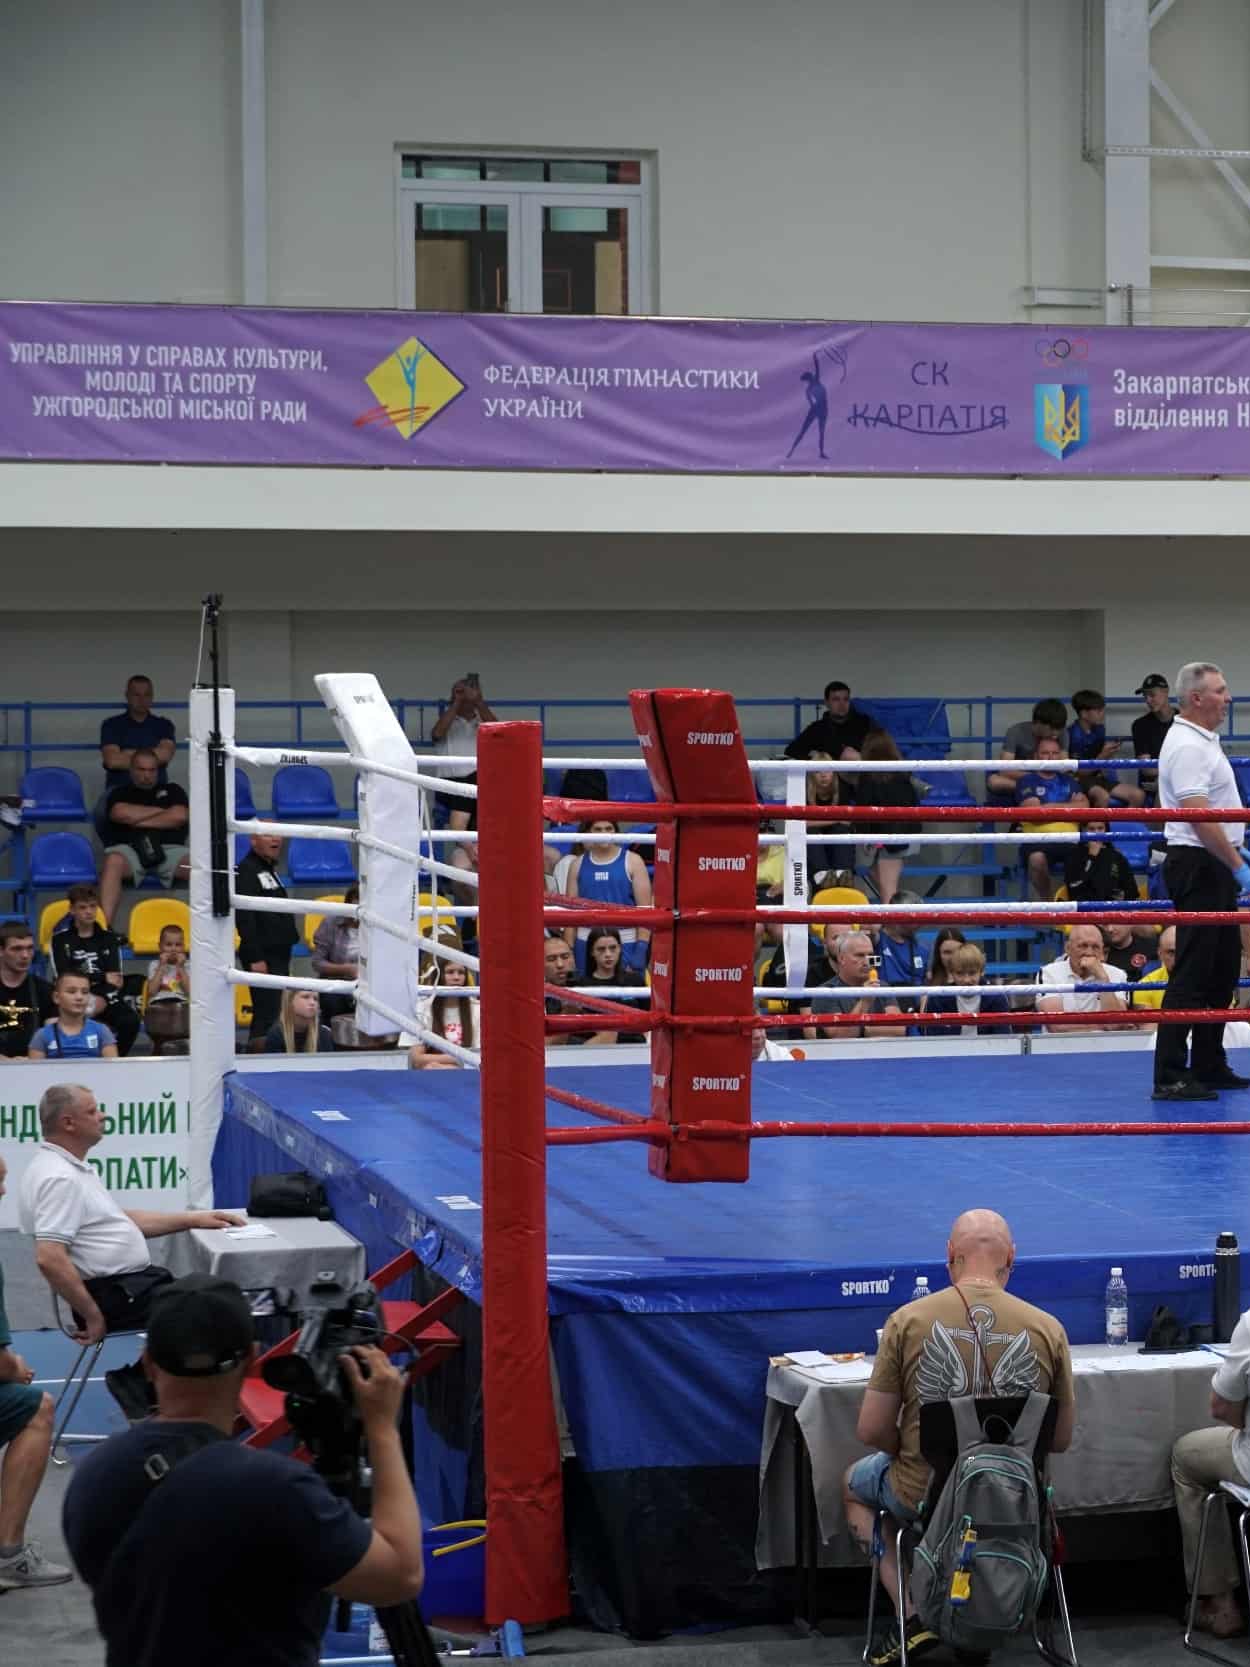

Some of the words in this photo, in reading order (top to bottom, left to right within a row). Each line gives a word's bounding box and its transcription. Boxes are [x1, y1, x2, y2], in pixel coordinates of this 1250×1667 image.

[10, 343, 123, 365] УПРАВЛІННЯ
[129, 346, 141, 366] У
[147, 346, 226, 368] СПРАВАХ
[233, 348, 328, 372] КУЛЬТУРИ,
[86, 371, 155, 395] МОЛОДІ
[162, 373, 183, 393] ТА
[189, 374, 256, 394] СПОРТУ
[484, 366, 611, 391] ФЕДЕРАЦІЯ
[614, 368, 760, 389] ГІМНАСТИКИ
[911, 361, 949, 385] СК
[32, 395, 173, 419] УЖГОРОДСЬКОЇ
[180, 397, 253, 421] МІСЬКОЇ
[261, 401, 307, 424] РАДИ
[484, 396, 584, 418] УКРАЇНИ
[852, 404, 1006, 429] КАРПАТІЯ
[1114, 403, 1228, 430] відділення
[687, 732, 734, 745] SPORTKO
[699, 857, 746, 871] SPORTKO
[695, 968, 742, 982] SPORTKO
[692, 1077, 740, 1091] SPORTKO
[1179, 1264, 1217, 1279] SPORT
[841, 1280, 889, 1296] SPORTKO
